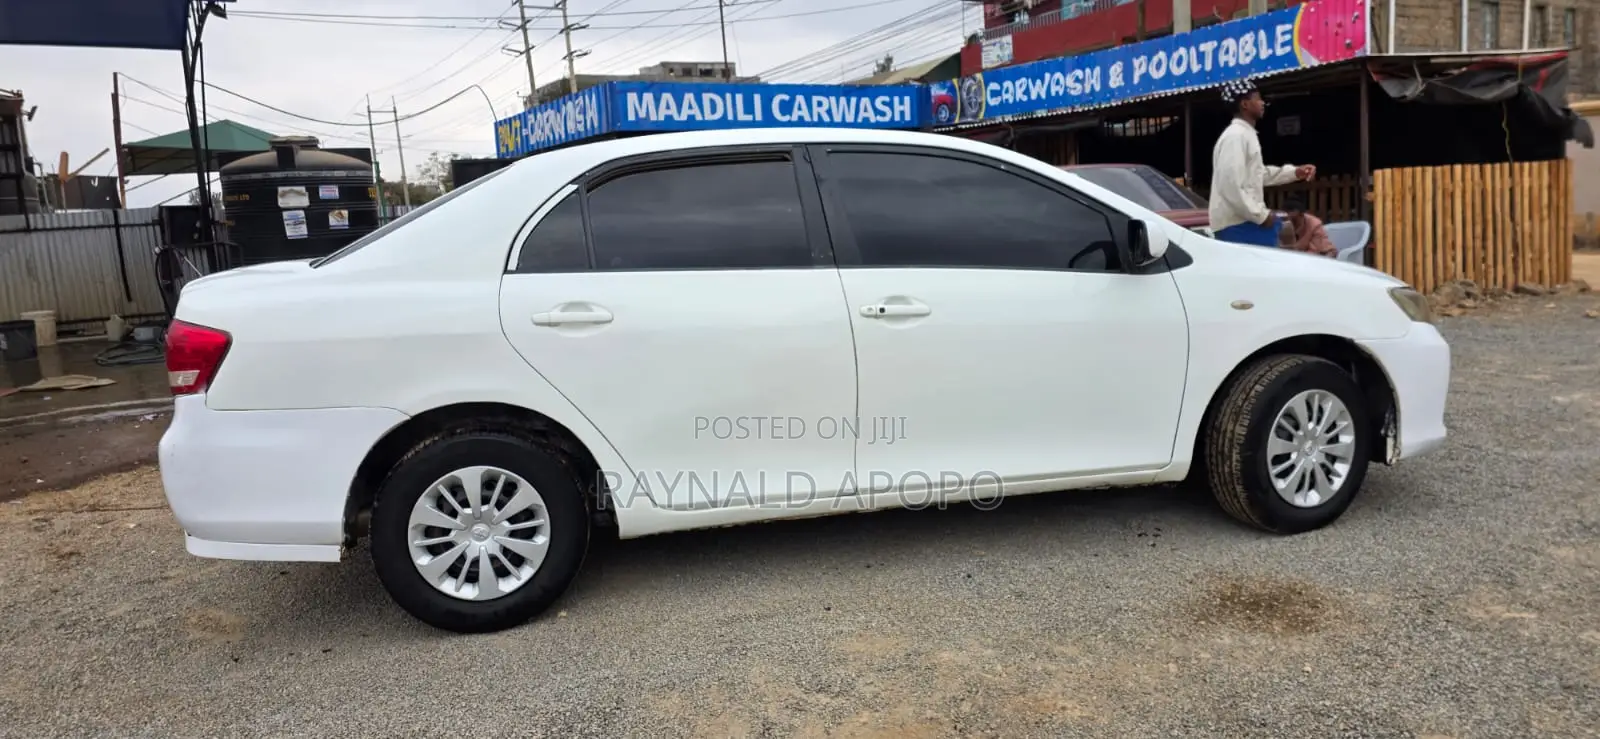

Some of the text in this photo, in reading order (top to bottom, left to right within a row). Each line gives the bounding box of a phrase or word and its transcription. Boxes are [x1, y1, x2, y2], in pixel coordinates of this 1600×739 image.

[986, 23, 1294, 106] CARWASH & POOLTABLE
[626, 91, 911, 123] MAADILI CARWASH
